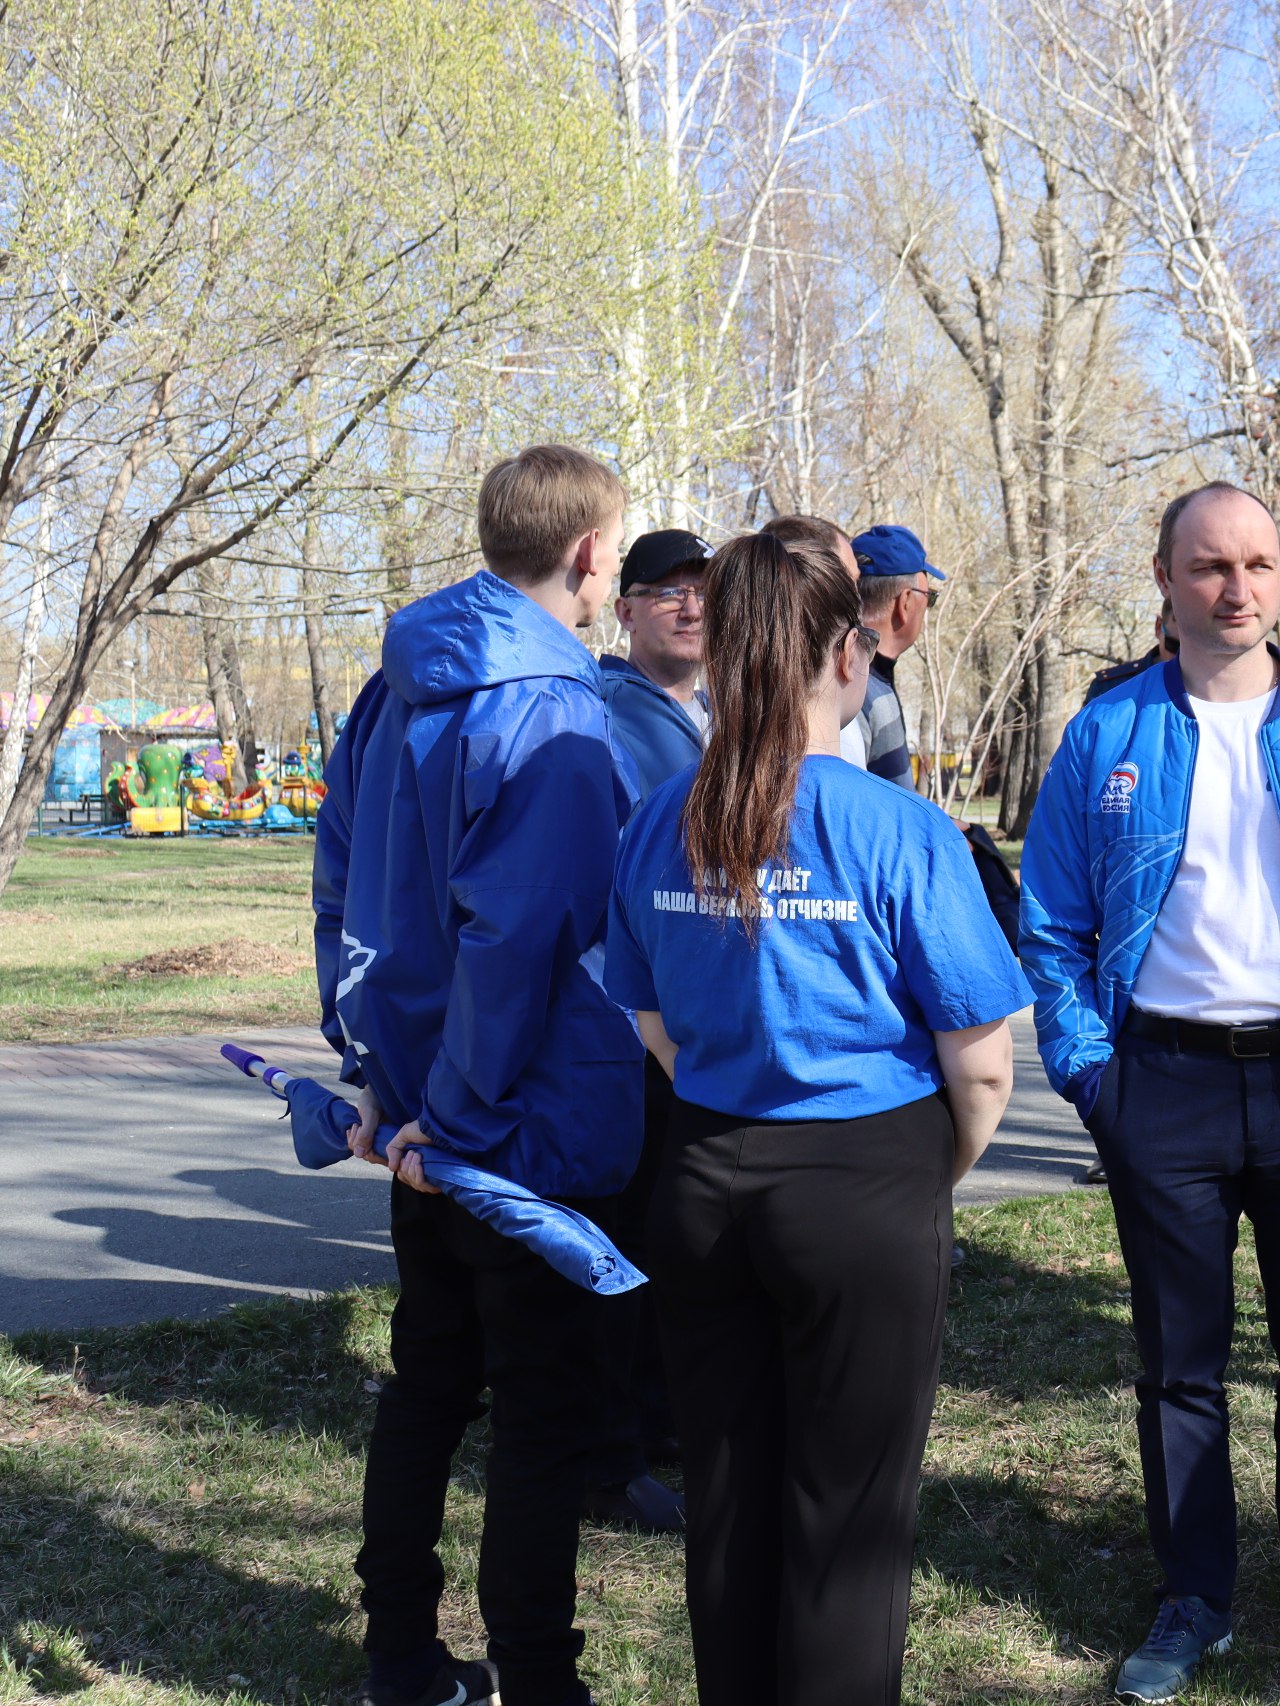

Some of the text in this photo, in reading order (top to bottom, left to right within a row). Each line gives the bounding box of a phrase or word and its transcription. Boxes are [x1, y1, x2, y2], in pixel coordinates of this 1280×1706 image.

[767, 866, 812, 893] ДАЁТ
[653, 890, 696, 914] НАША
[776, 898, 858, 922] ОТЧИЗНЕ
